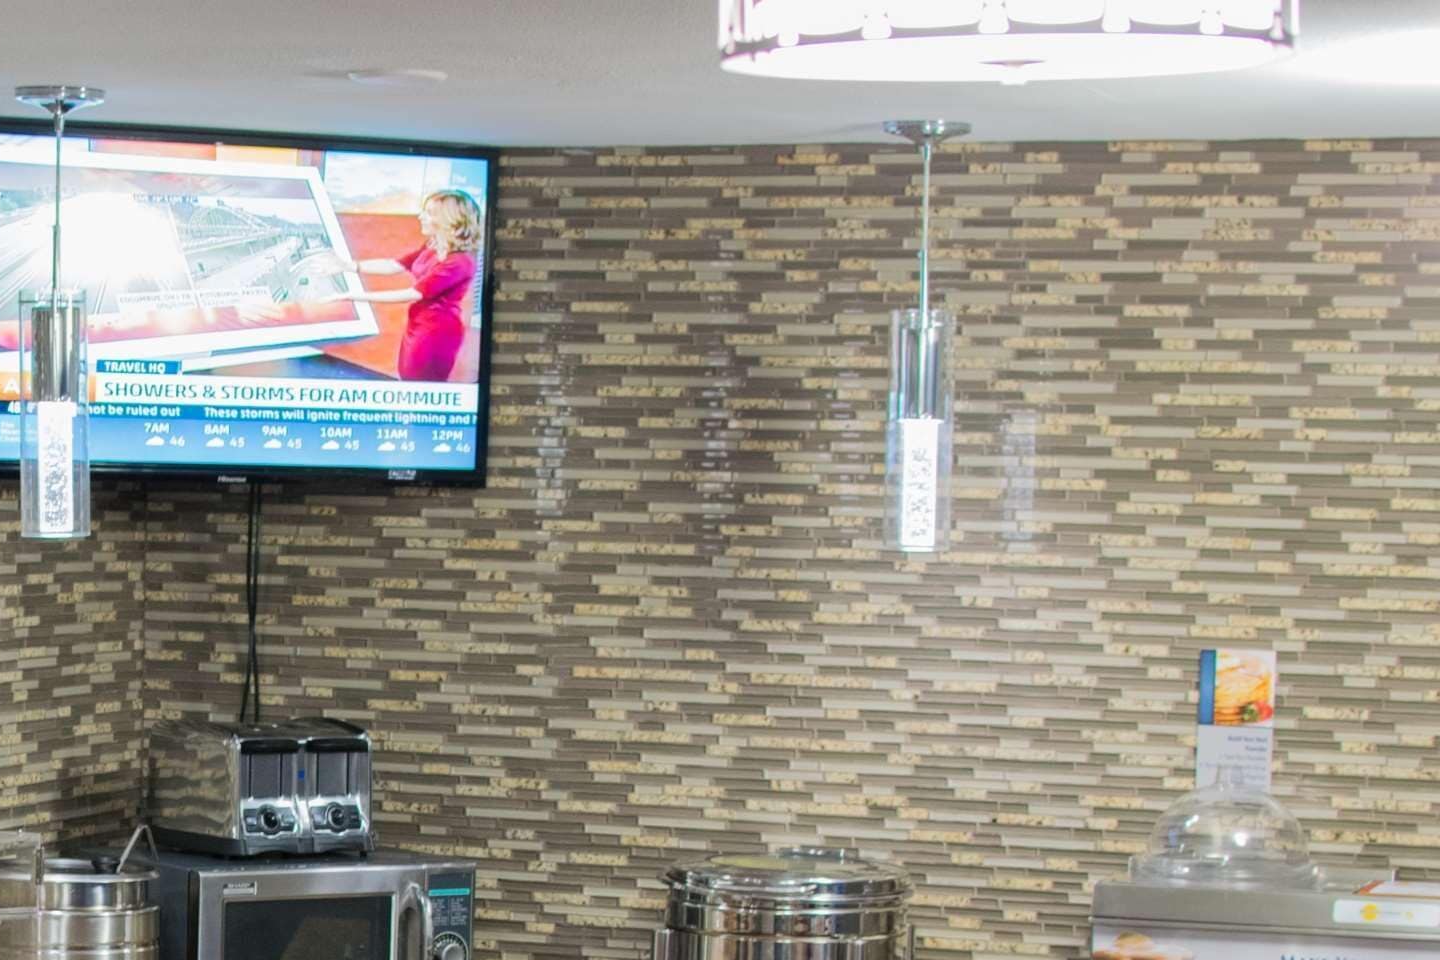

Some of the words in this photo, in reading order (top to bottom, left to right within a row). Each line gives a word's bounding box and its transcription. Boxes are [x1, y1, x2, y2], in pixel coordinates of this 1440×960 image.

[104, 361, 146, 373] TRAVEL
[148, 362, 166, 374] HQ
[104, 382, 197, 399] SHOWERS
[202, 385, 215, 399] &
[221, 385, 294, 401] STORMS
[299, 387, 335, 403] FOR
[339, 388, 367, 403] AM
[371, 389, 462, 407] COMMUTE
[107, 405, 123, 415] be
[126, 405, 158, 417] ruled
[160, 406, 180, 417] out
[204, 407, 238, 419] These
[240, 409, 279, 420] storms
[282, 410, 305, 420] will
[307, 410, 340, 423] ignite
[342, 411, 392, 424] frequent
[394, 412, 446, 426] lightning
[448, 414, 470, 425] and
[144, 422, 170, 433] 7AM
[204, 424, 230, 435] 8AM
[262, 425, 288, 436] 9AM
[319, 427, 353, 439] 10AM
[376, 429, 408, 439] 11AM
[432, 430, 463, 441] 12PM
